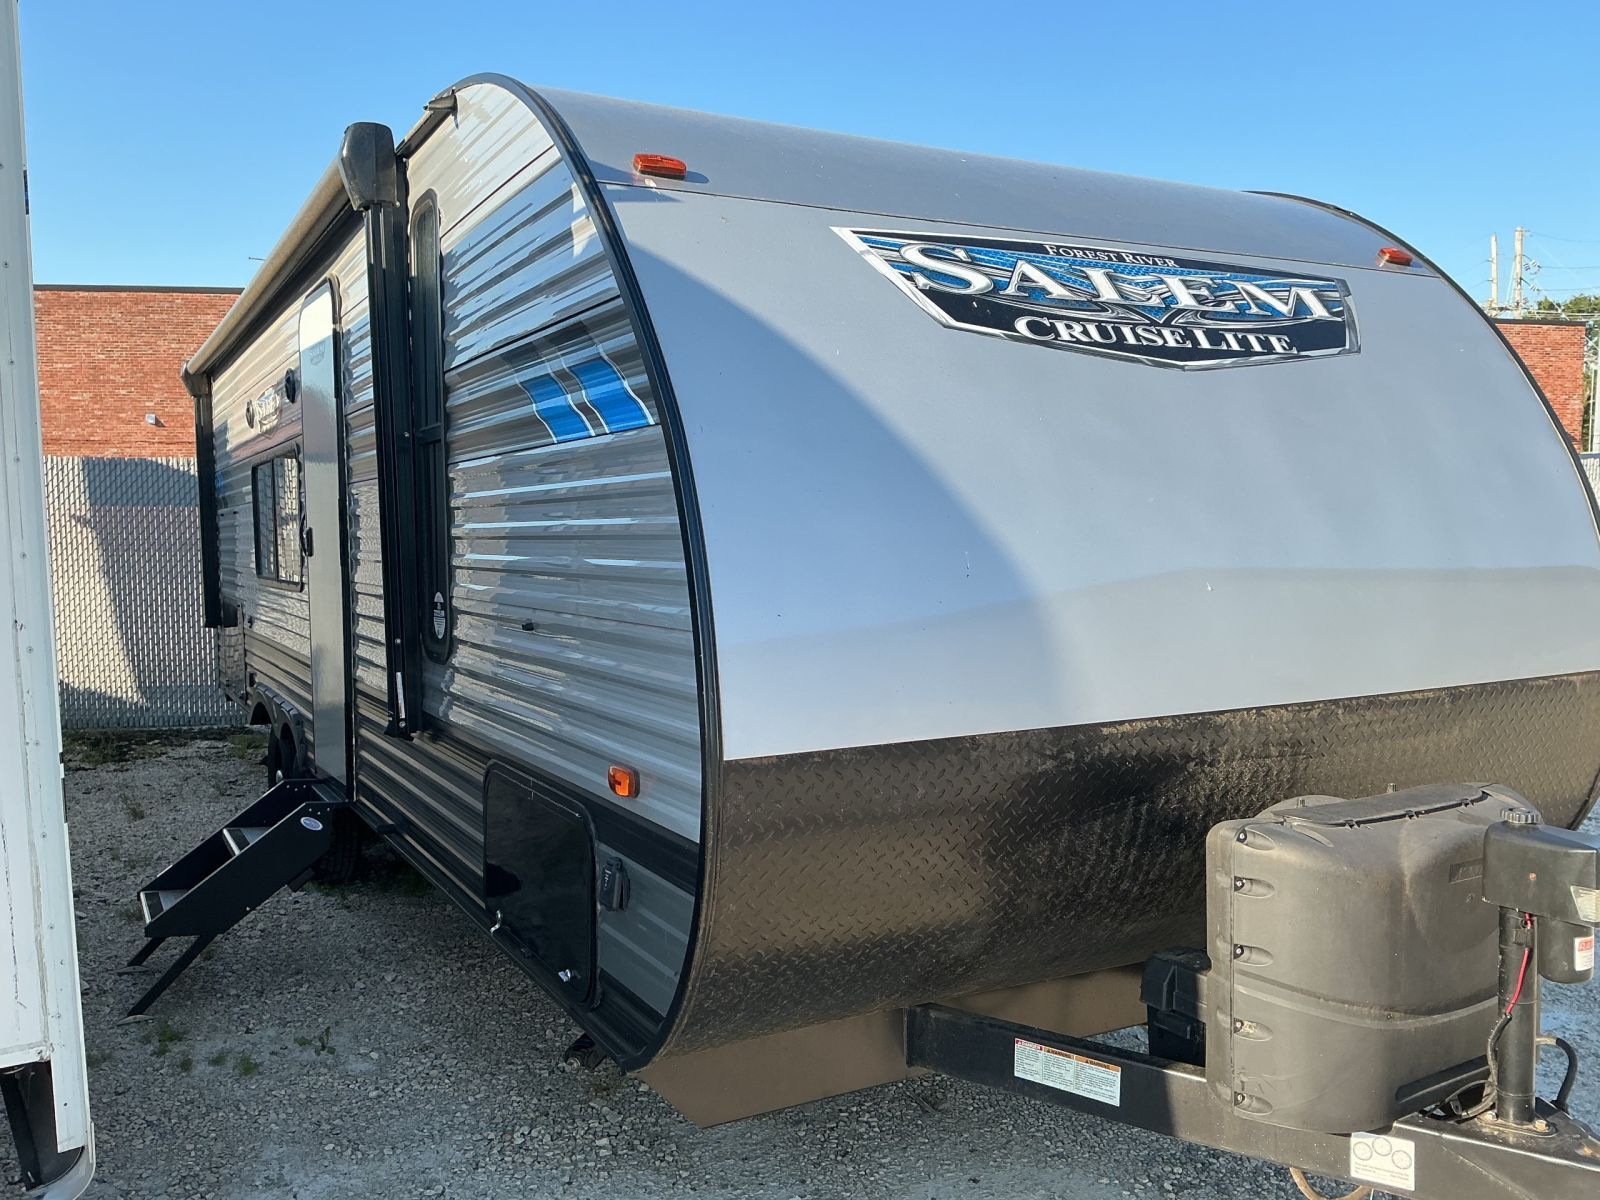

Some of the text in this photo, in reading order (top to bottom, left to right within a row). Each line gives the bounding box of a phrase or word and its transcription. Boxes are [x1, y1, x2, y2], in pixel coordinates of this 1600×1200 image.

[1045, 245, 1180, 268] FOREST RIVER
[898, 243, 1347, 321] SALEM
